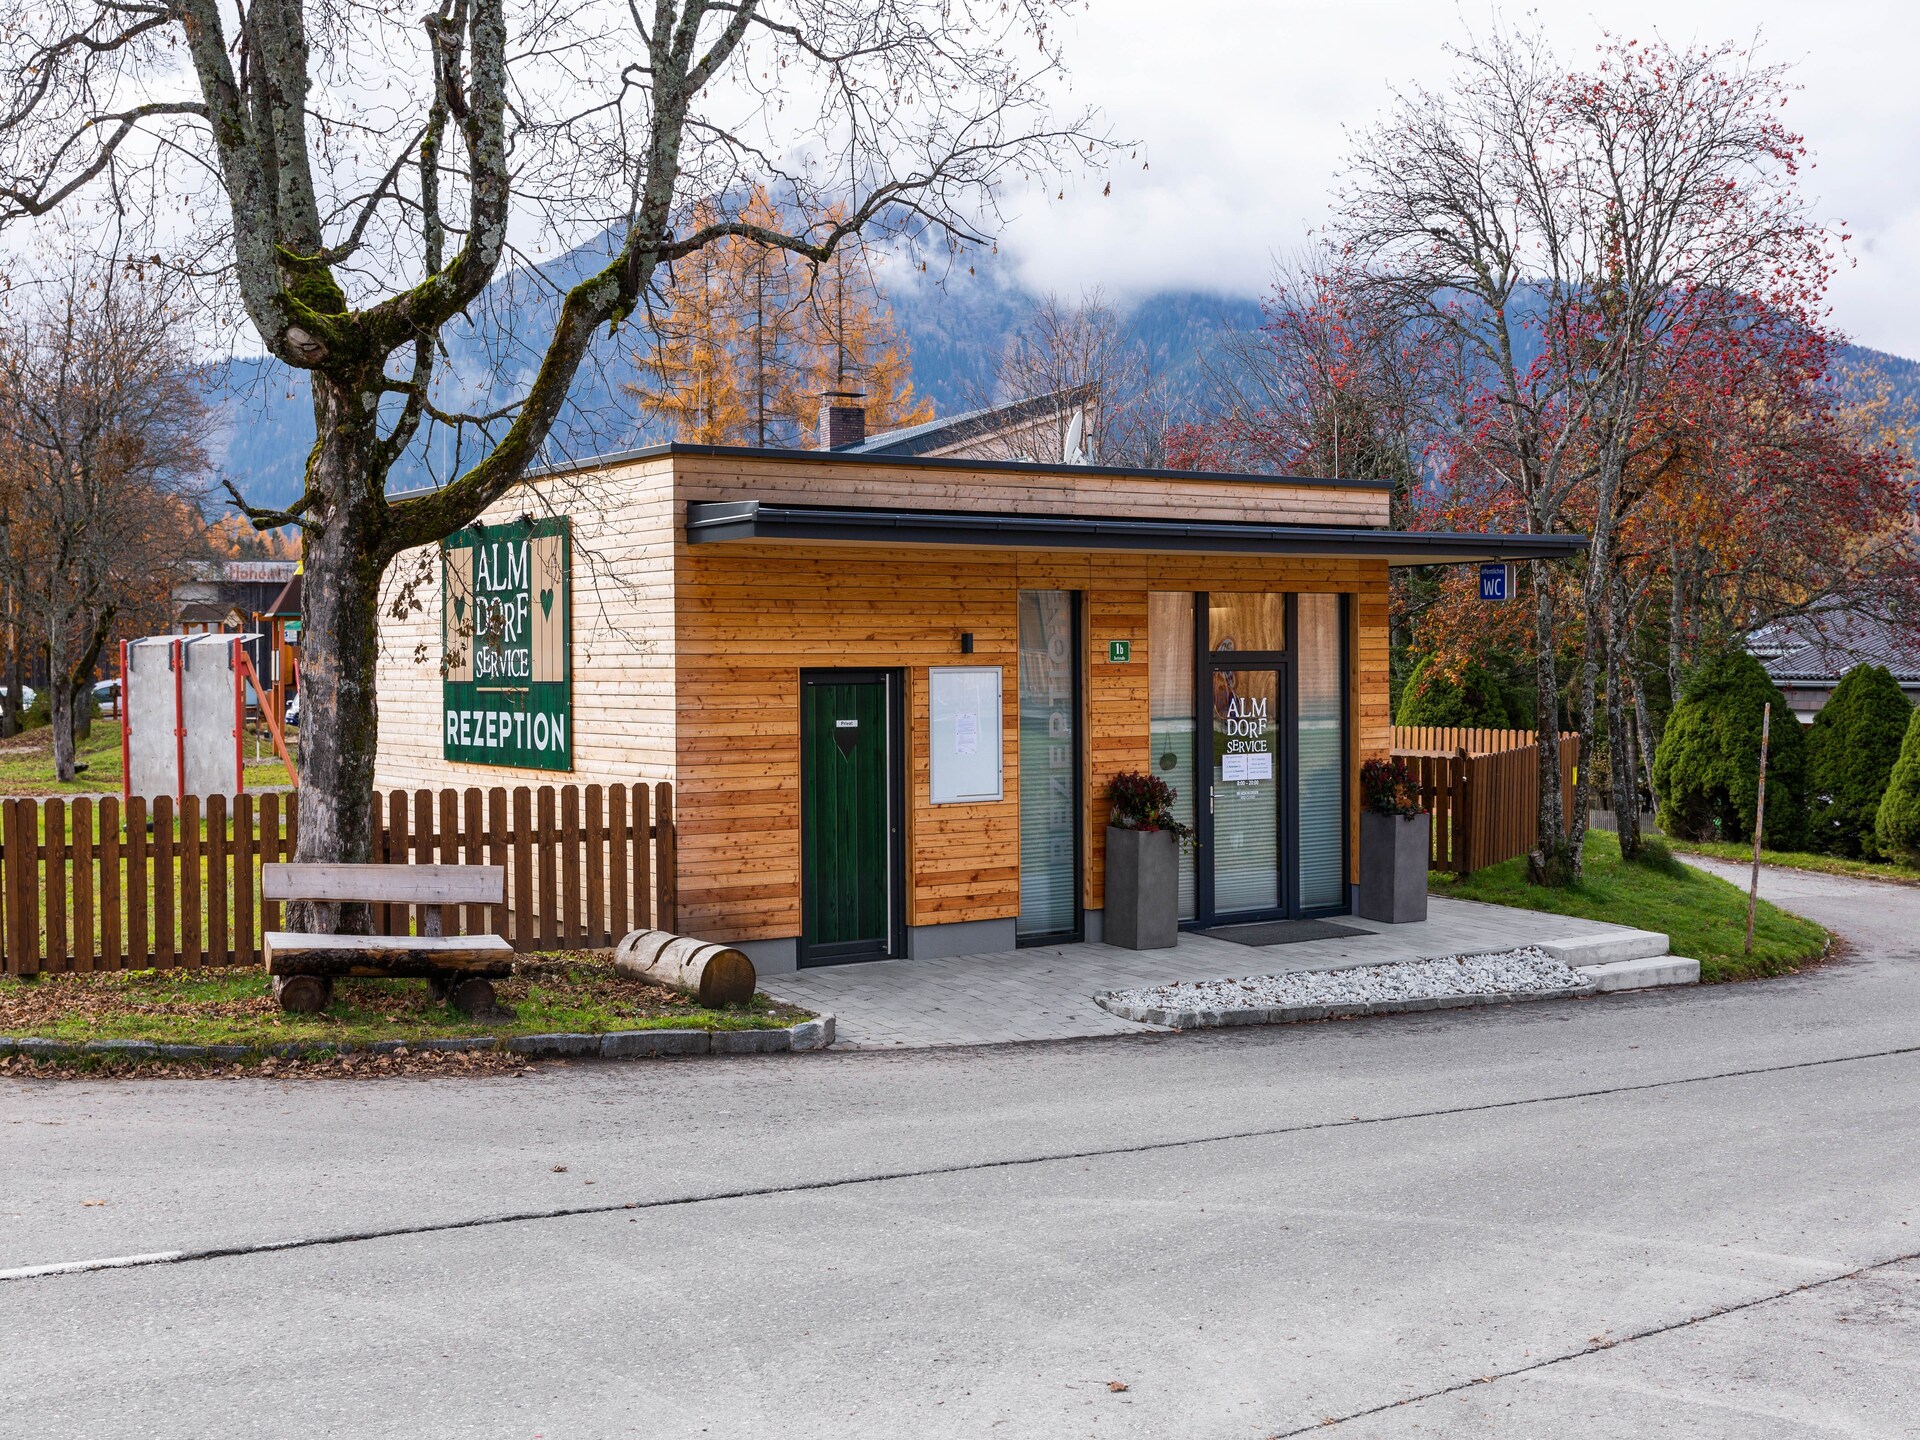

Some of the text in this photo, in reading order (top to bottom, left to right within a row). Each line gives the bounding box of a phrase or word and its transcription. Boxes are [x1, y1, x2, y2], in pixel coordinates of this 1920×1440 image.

[476, 540, 529, 592] ALM
[1484, 578, 1501, 596] WC
[475, 592, 529, 643] DORF
[1116, 642, 1124, 655] 1b
[475, 645, 530, 679] SERVICE
[1227, 697, 1267, 718] ALM
[446, 709, 565, 753] REZEPTION
[1227, 718, 1267, 738] DORF
[1227, 740, 1267, 753] SERVICE
